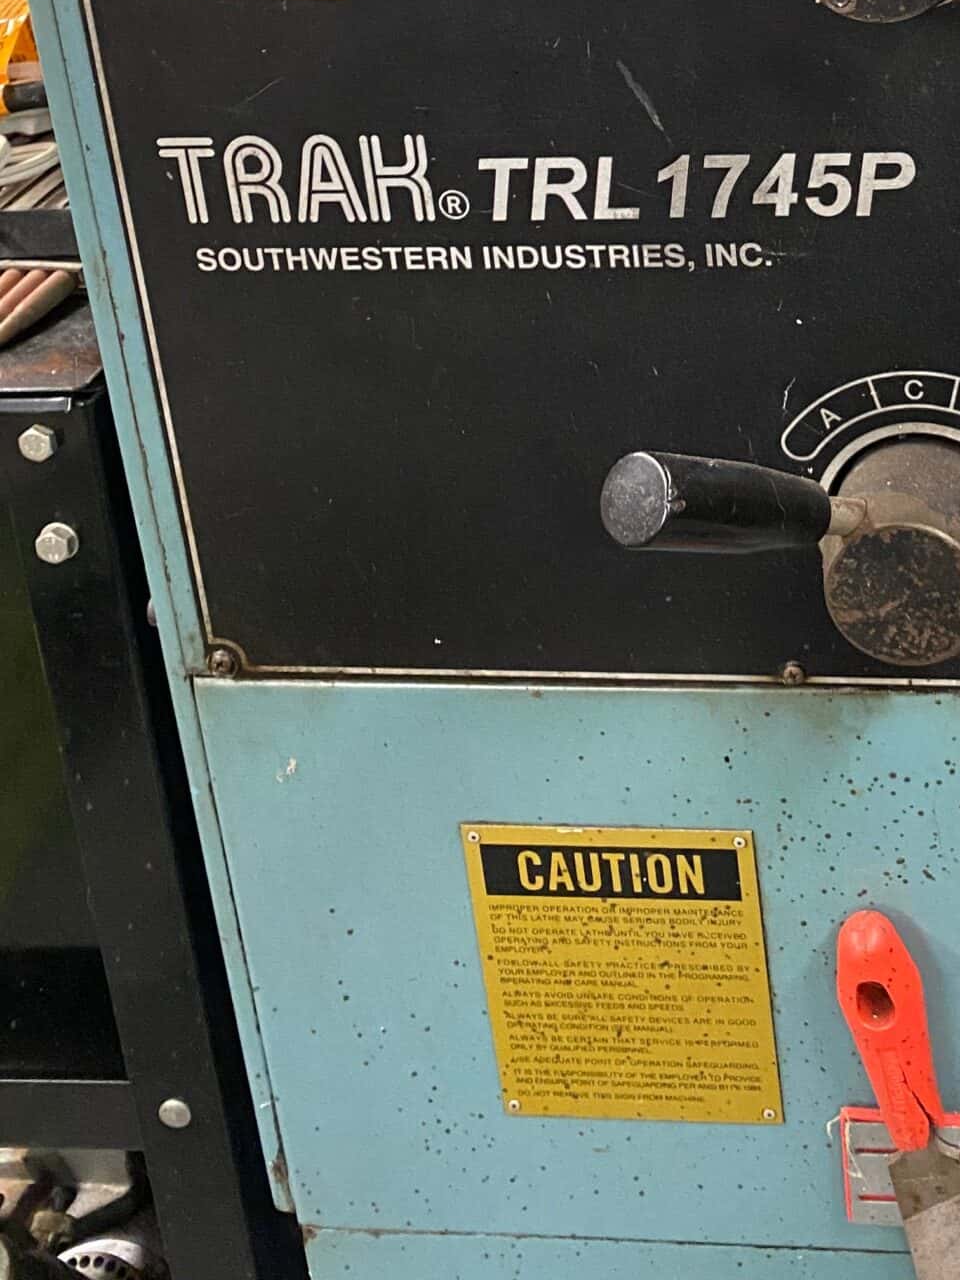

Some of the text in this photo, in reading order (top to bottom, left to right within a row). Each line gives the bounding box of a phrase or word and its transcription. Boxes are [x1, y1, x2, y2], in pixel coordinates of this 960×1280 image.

[477, 155, 640, 223] TRL
[656, 150, 917, 219] 1745P
[195, 241, 775, 273] SOUTHWESTERN INDUSTRIES, INC.
[819, 406, 842, 430] A
[904, 379, 925, 401] C
[516, 849, 706, 895] CAUTION
[488, 904, 539, 912] IMPROPER
[542, 905, 598, 913] OPERATION
[618, 906, 670, 915] IMPROPER
[531, 927, 577, 935] OPERATE
[613, 929, 641, 937] UNTIL
